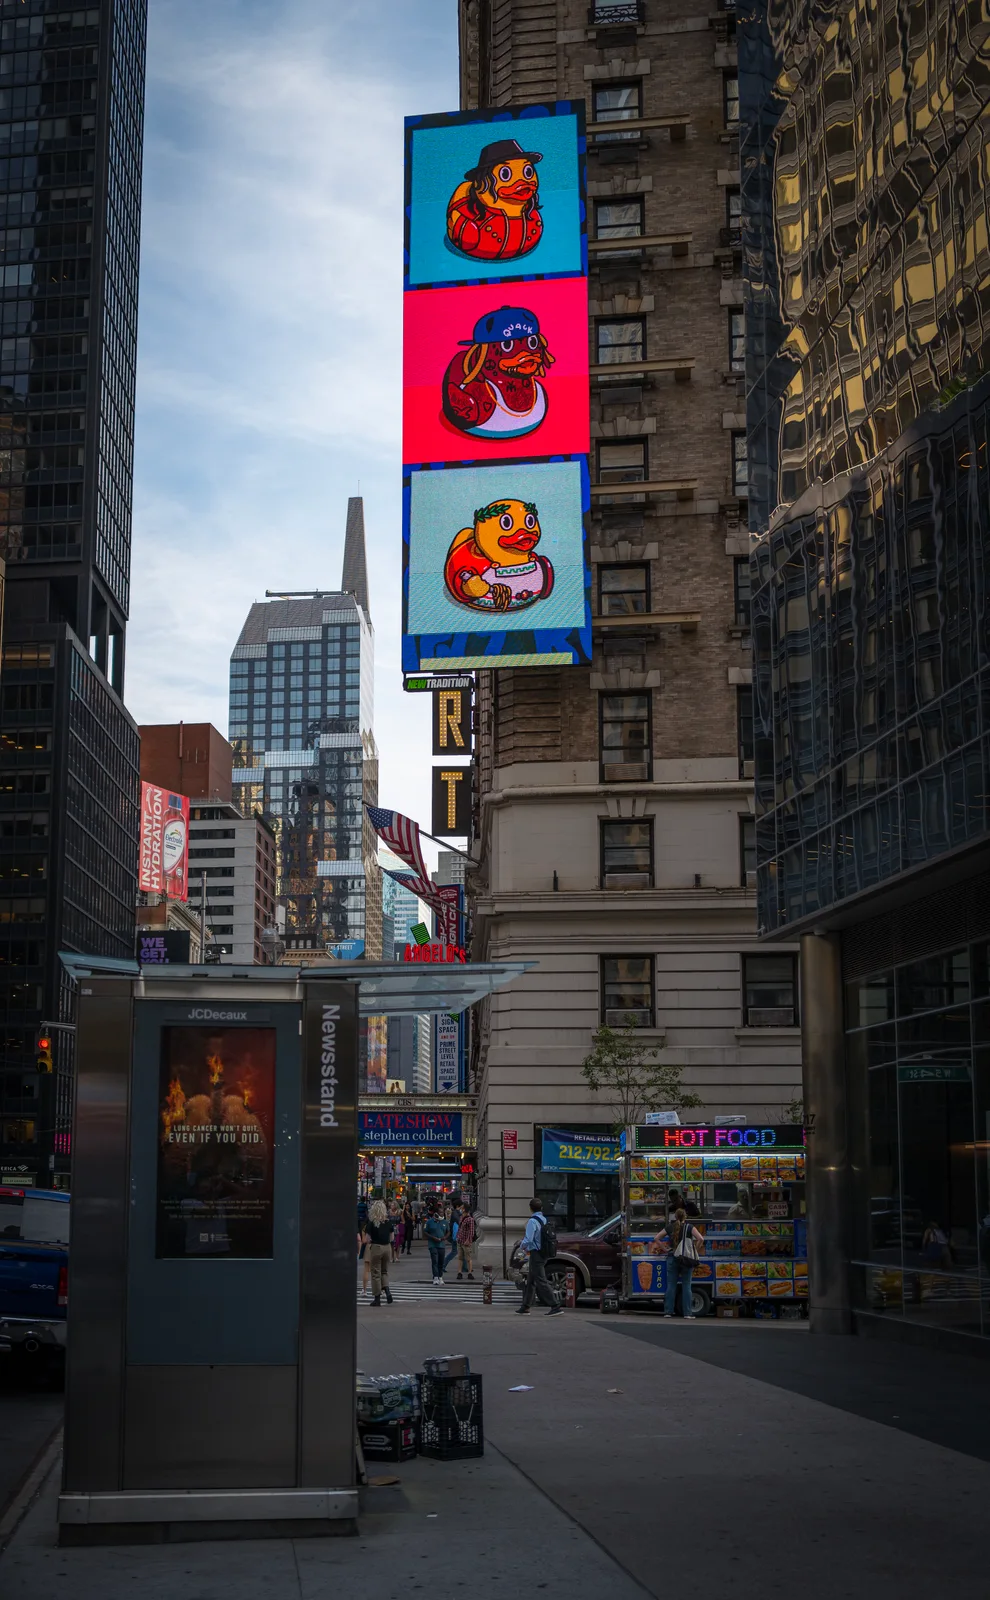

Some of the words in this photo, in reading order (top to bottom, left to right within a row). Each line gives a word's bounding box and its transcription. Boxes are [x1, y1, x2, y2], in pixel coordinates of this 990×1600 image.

[503, 323, 533, 337] QUACK
[439, 690, 465, 747] R
[441, 772, 463, 829] T
[151, 788, 163, 890] HYDRATION
[142, 810, 152, 887] INSTANT
[141, 937, 165, 948] WE
[140, 947, 168, 959] GET
[188, 1008, 248, 1020] JCDecaux
[438, 1026, 457, 1034] SPACE
[320, 1005, 340, 1127] Newsstand
[363, 1113, 404, 1129] LATE
[405, 1113, 455, 1129] SHOW
[169, 1133, 195, 1143] EVEN
[200, 1133, 211, 1143] IF
[216, 1133, 236, 1143] YOU
[241, 1133, 264, 1143] DID.
[364, 1129, 411, 1145] stephen
[413, 1129, 454, 1141] colbert
[573, 1134, 597, 1142] RETAIL
[664, 1129, 709, 1147] HOT
[715, 1129, 776, 1147] FOOD
